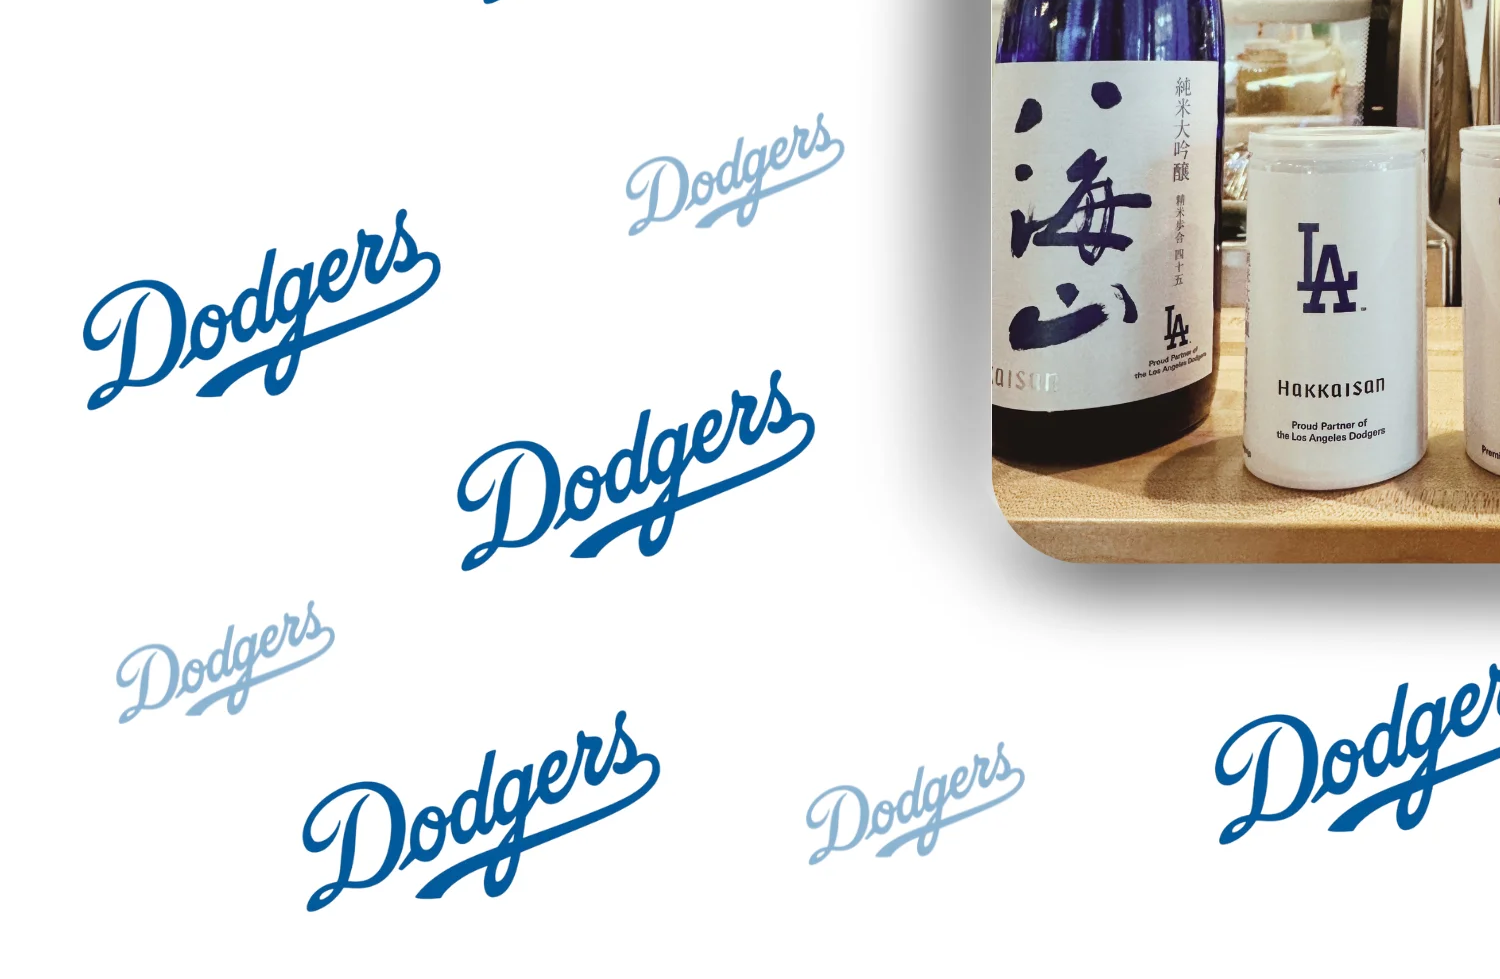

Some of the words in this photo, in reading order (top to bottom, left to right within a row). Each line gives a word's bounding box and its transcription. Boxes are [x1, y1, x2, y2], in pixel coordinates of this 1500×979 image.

[1009, 81, 1152, 351] 八海山
[1297, 223, 1358, 313] LA
[1164, 305, 1189, 350] LA
[1134, 371, 1147, 380] the
[1148, 368, 1161, 376] Los
[1162, 360, 1187, 373] Angeles
[1187, 352, 1207, 365] Dodgers
[1149, 356, 1169, 367] Proud
[1171, 350, 1192, 361] Partner
[1193, 346, 1198, 354] of
[992, 366, 1059, 393] aisan
[1278, 378, 1385, 398] Hakkaisan
[1277, 430, 1290, 440] the
[1292, 432, 1307, 442] Los
[1309, 433, 1347, 444] Angeles
[1349, 428, 1386, 441] Dodgers
[1291, 421, 1318, 430] Proud
[1321, 422, 1355, 430] Partner
[1358, 418, 1368, 428] of
